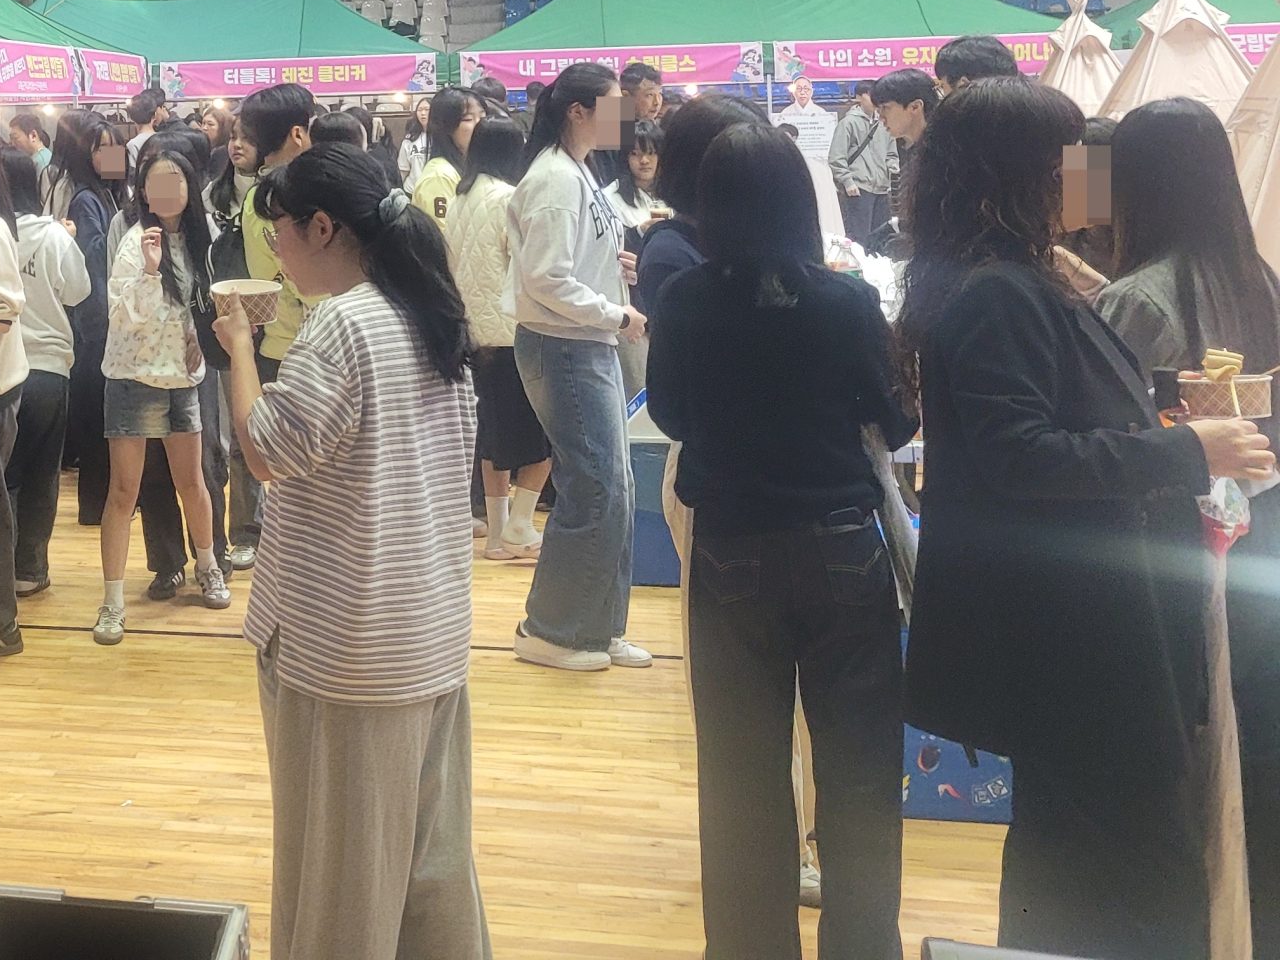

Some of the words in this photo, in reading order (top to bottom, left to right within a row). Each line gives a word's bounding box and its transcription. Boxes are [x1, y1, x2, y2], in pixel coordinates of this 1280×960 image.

[818, 50, 852, 67] 나의
[857, 48, 897, 67] 소원,
[281, 66, 314, 84] 레진
[318, 64, 366, 83] 클리커
[518, 59, 535, 76] 내
[433, 197, 447, 218] 6
